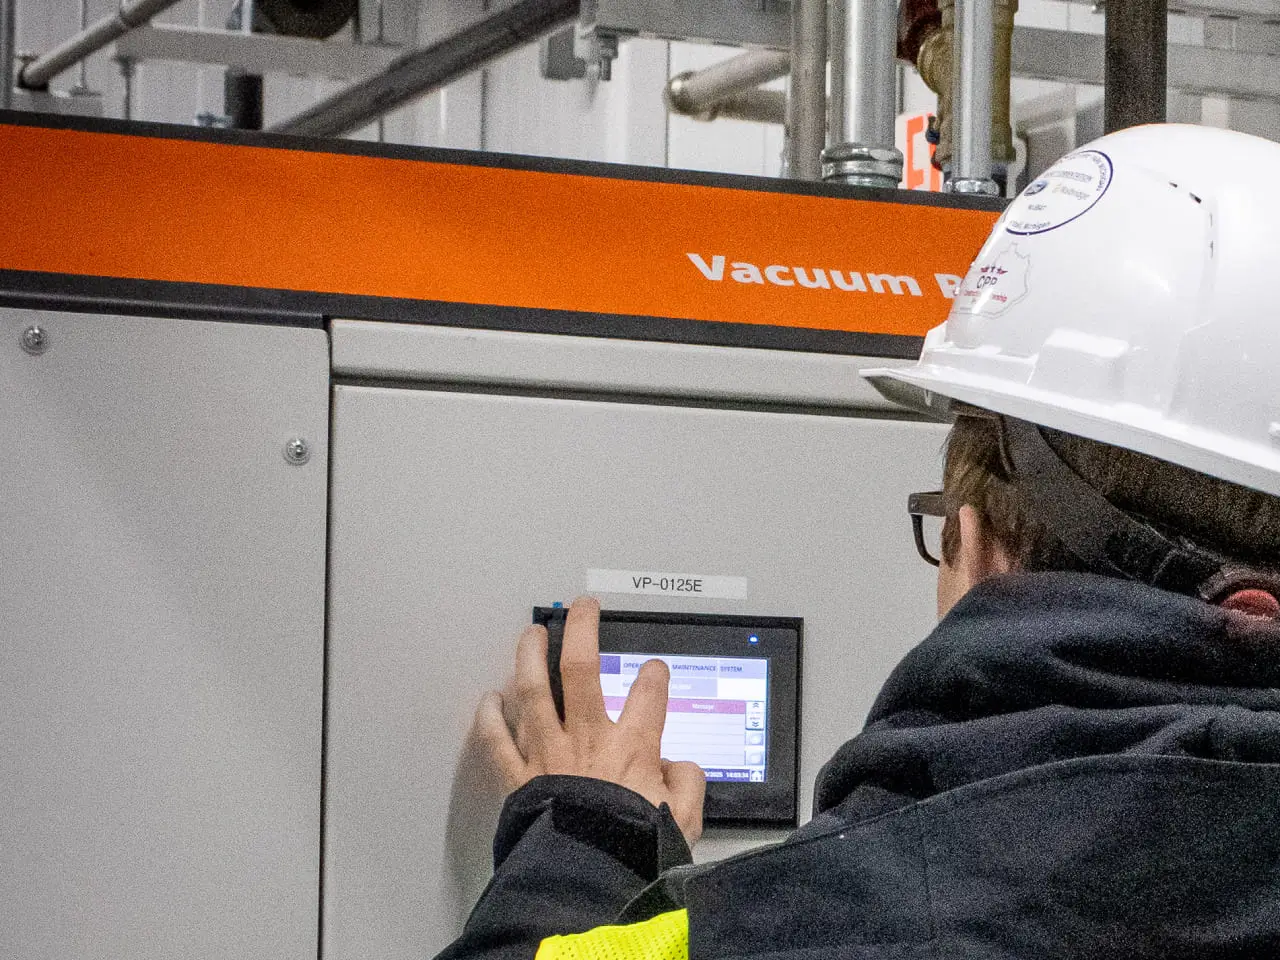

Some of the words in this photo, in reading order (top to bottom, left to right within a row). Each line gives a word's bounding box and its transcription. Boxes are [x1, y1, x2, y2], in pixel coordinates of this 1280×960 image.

[686, 252, 923, 297] Vacuum
[633, 576, 702, 593] VP-0125E
[672, 664, 717, 672] MAINTENANCE
